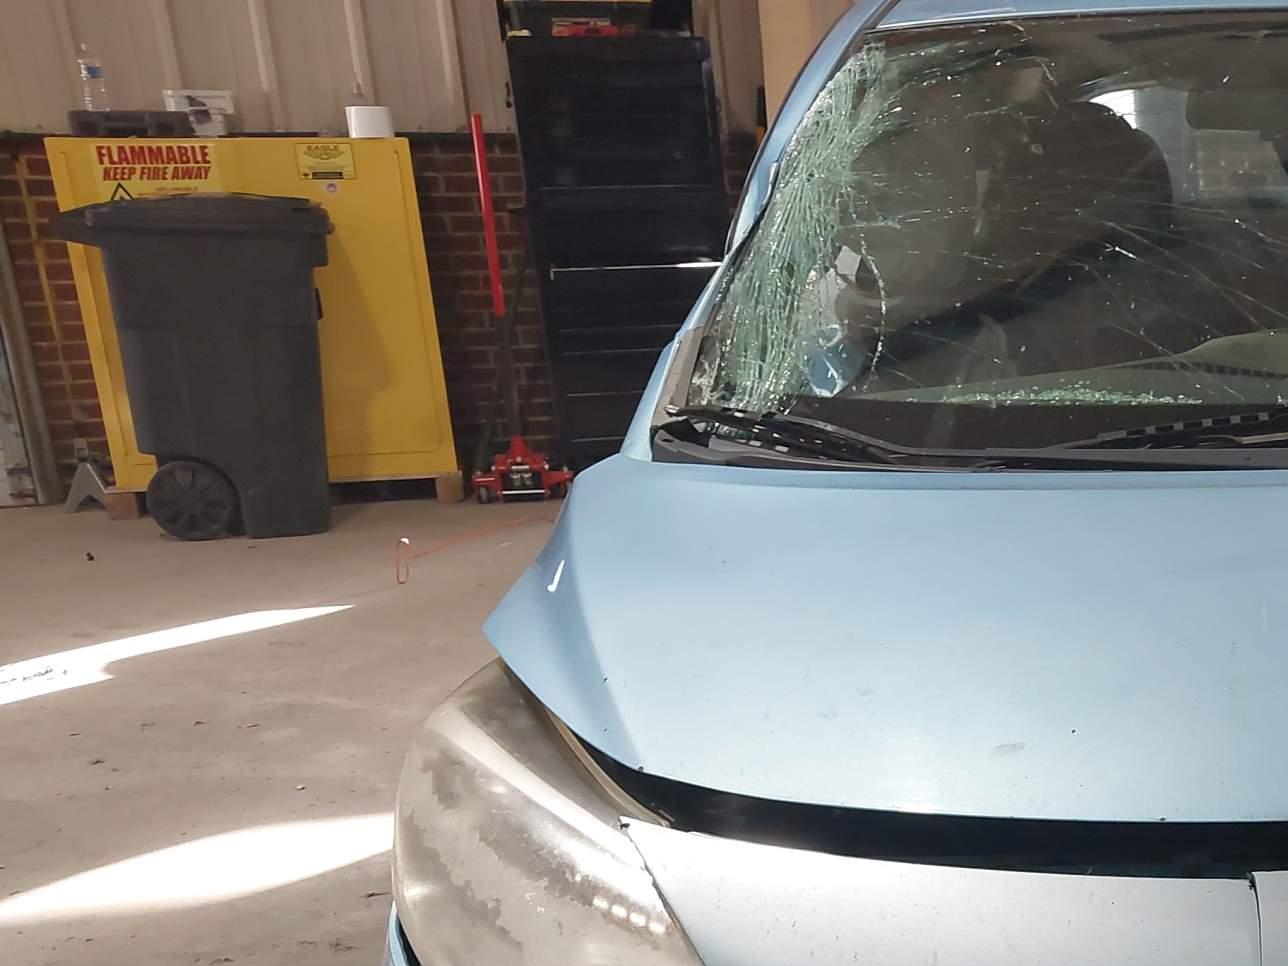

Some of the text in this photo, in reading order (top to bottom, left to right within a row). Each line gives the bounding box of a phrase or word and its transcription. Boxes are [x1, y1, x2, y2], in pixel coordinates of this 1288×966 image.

[96, 145, 211, 165] FLAMMABLE
[103, 166, 211, 181] KEEP FIRE AWAY
